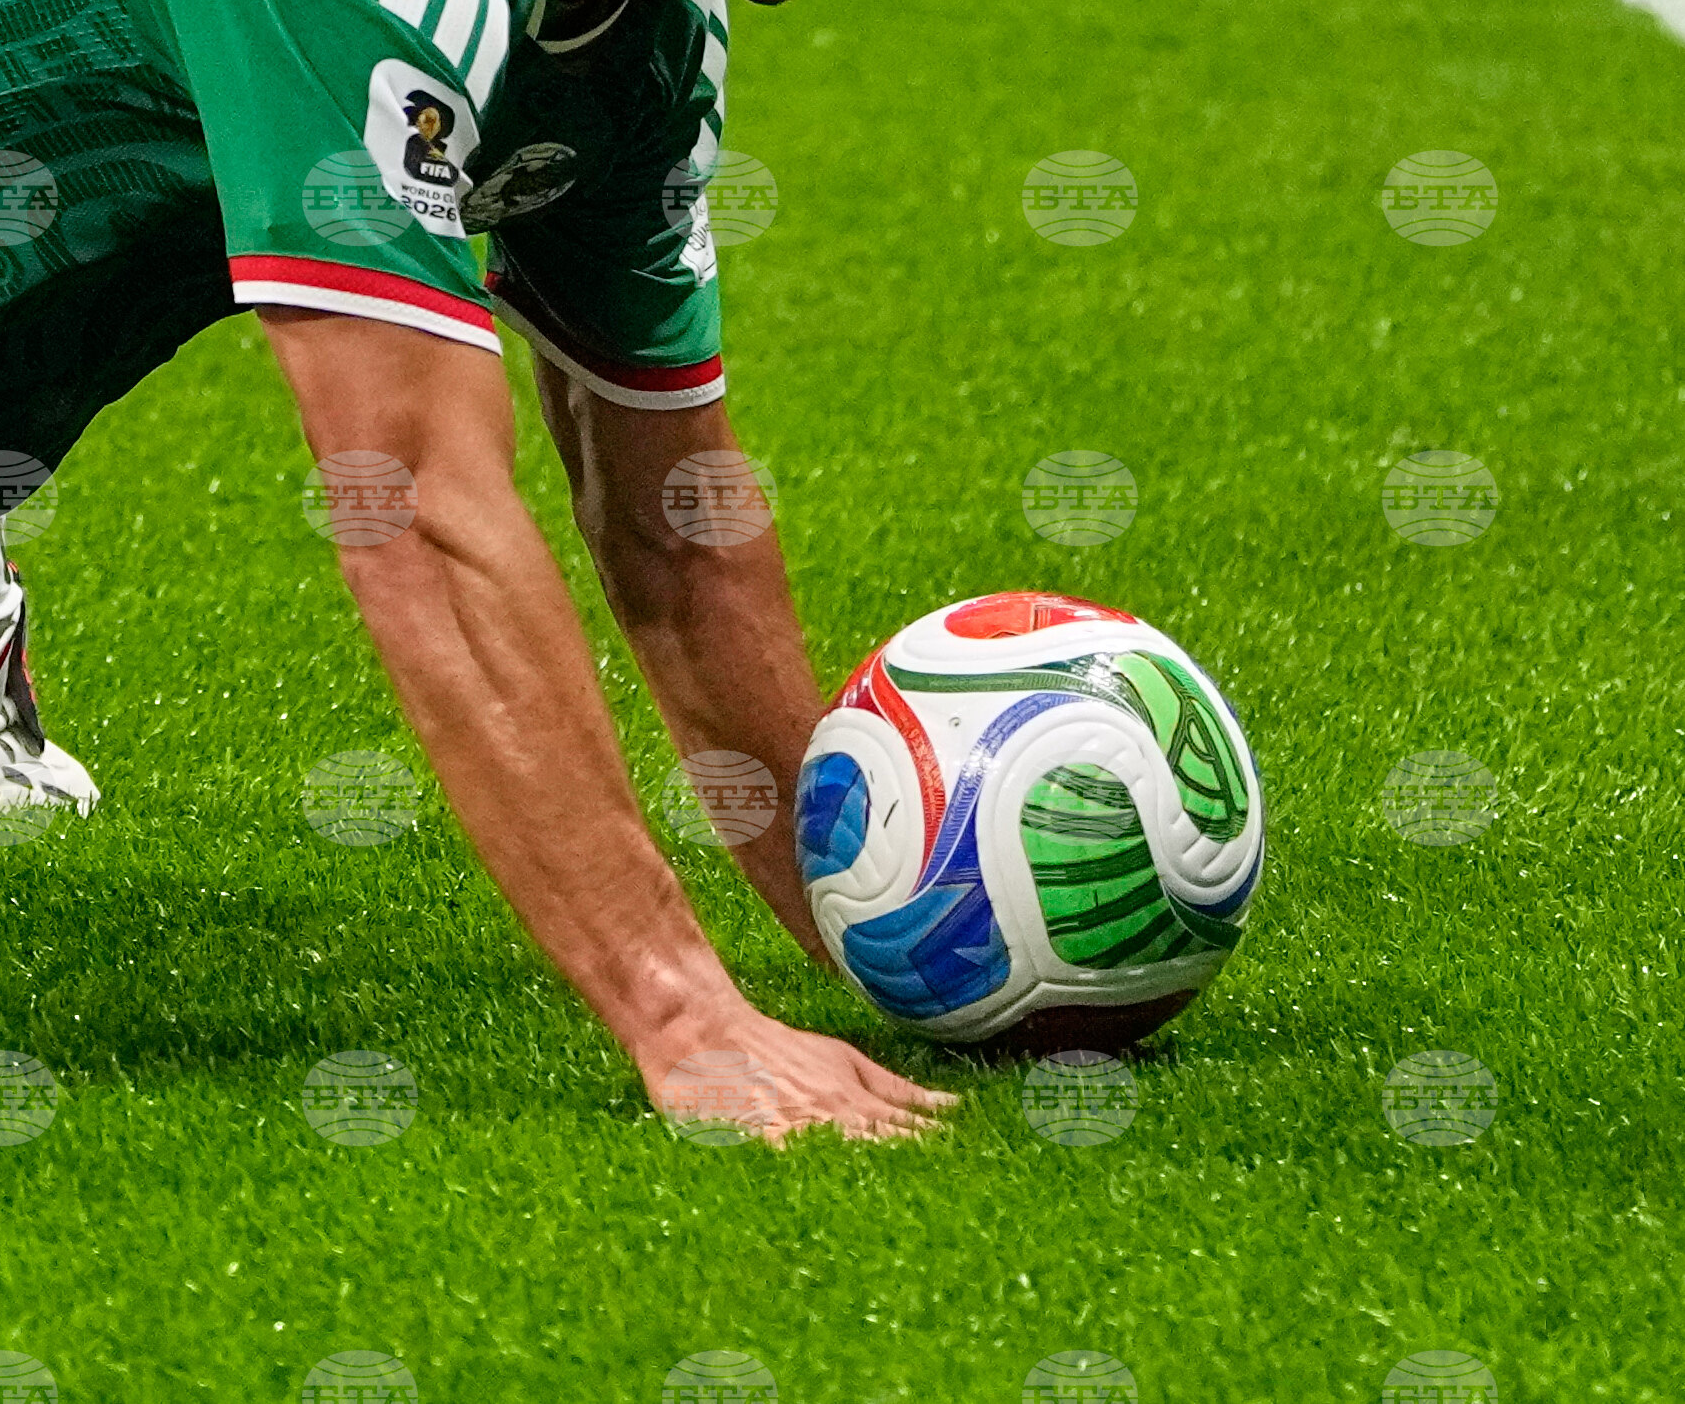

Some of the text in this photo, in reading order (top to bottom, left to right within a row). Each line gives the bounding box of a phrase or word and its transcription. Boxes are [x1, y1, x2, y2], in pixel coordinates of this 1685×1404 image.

[420, 162, 452, 179] FIFA
[401, 184, 440, 200] WORLD
[401, 195, 458, 222] 2026
